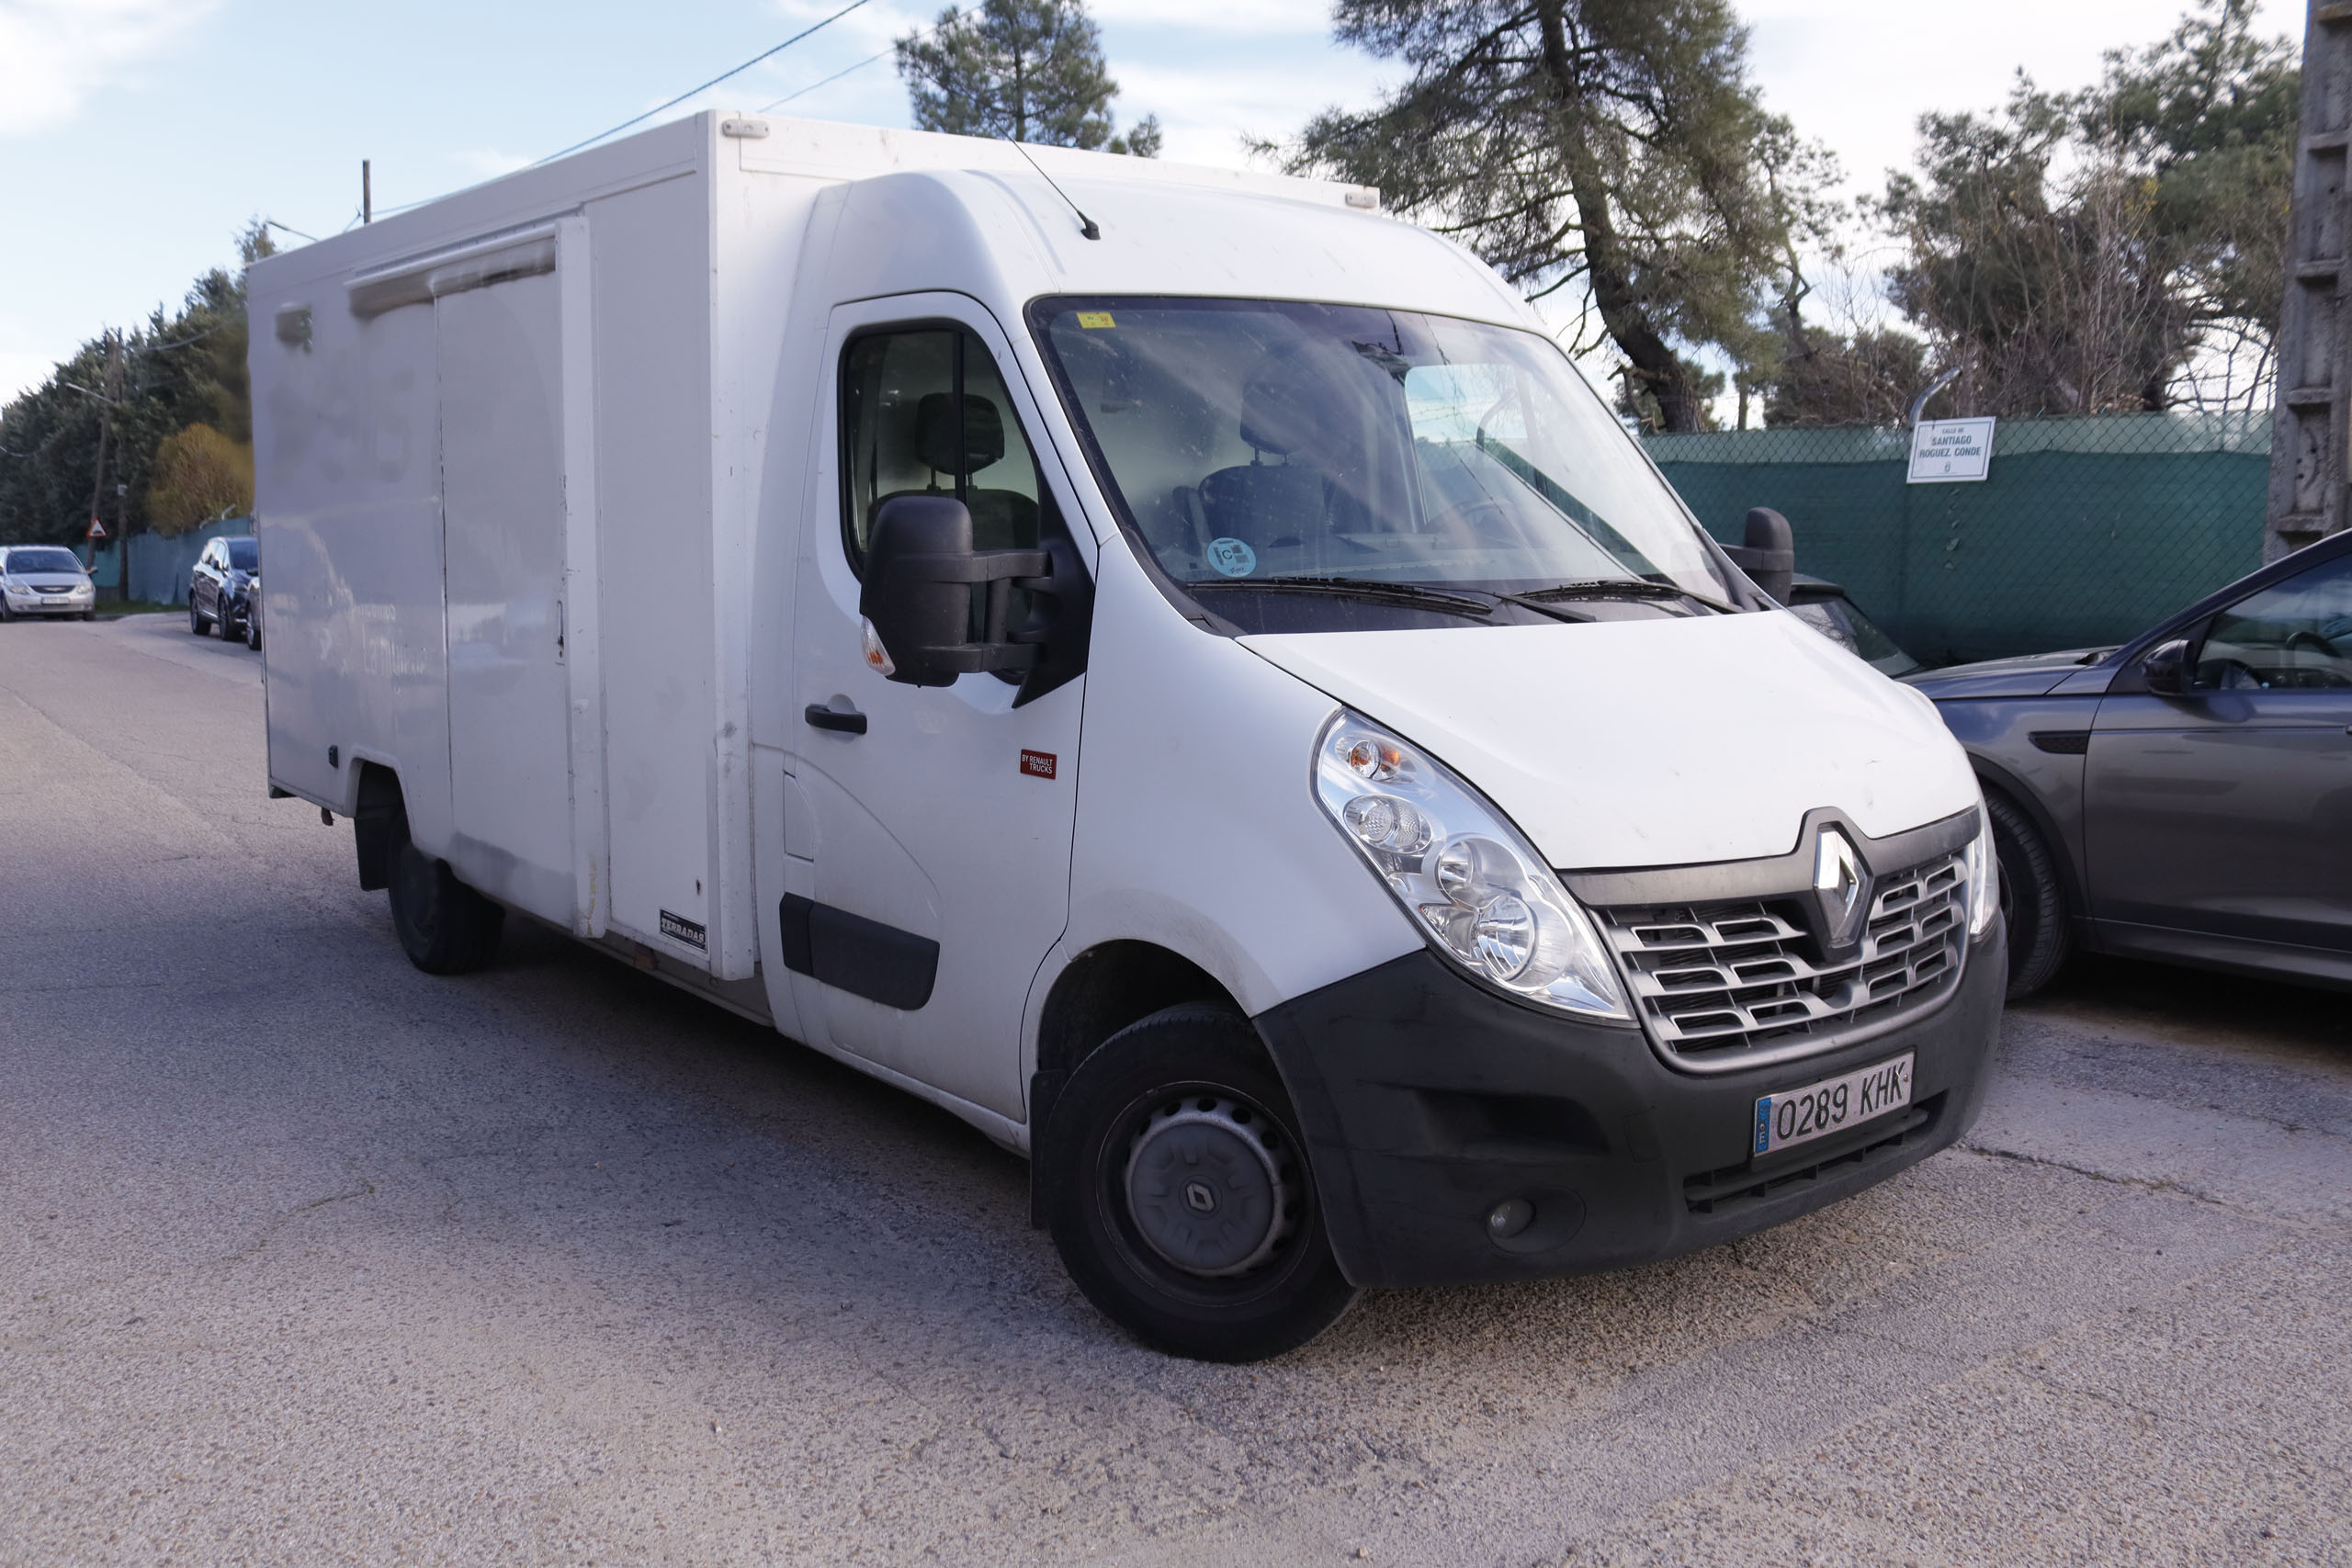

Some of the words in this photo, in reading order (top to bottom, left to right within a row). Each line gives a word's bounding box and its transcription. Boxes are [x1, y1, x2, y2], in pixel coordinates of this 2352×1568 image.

[1932, 434, 1973, 446] SANTIAGO
[1954, 446, 1982, 457] CONDE
[1022, 754, 1029, 762] BY
[1029, 755, 1053, 766] RENAULT
[1029, 763, 1053, 774] TRUCKS
[1776, 1082, 1849, 1140] 0289
[1860, 1061, 1905, 1116] KHK
